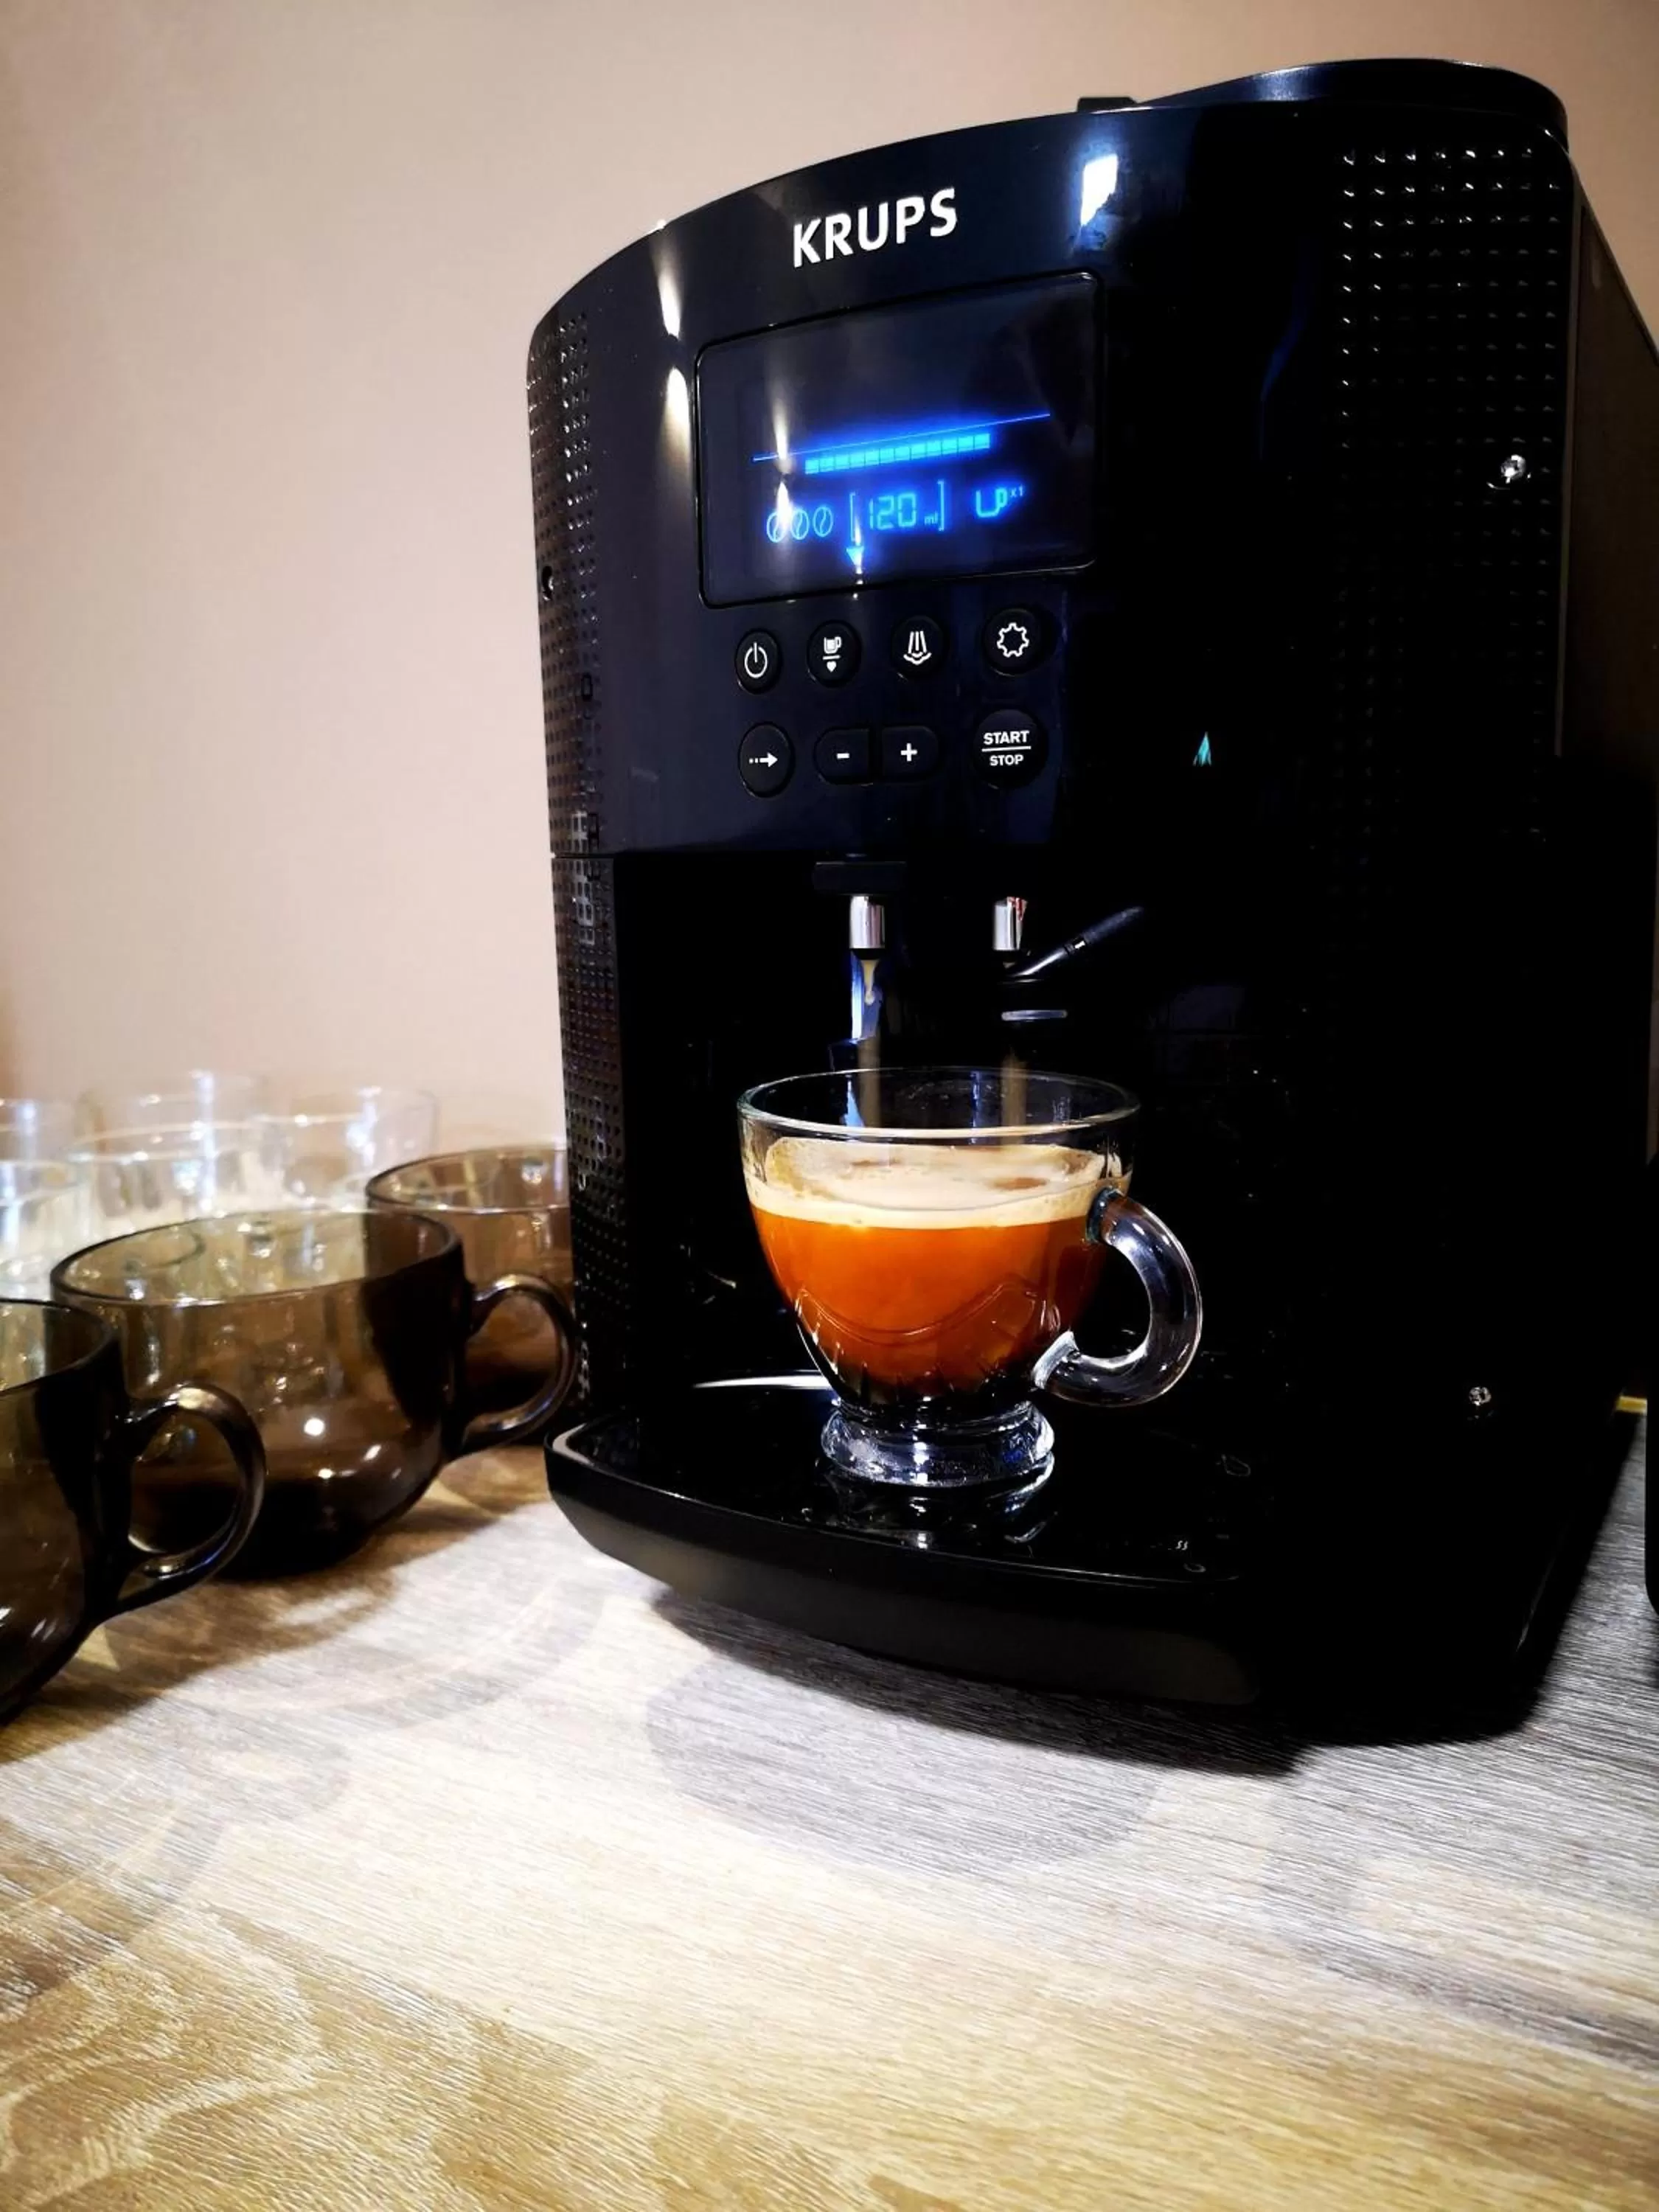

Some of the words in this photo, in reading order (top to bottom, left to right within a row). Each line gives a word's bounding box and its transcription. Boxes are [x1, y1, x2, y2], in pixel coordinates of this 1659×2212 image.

[793, 187, 958, 268] KRUPS
[869, 492, 917, 530] 120
[983, 729, 1031, 745] START
[989, 754, 1024, 766] STOP
